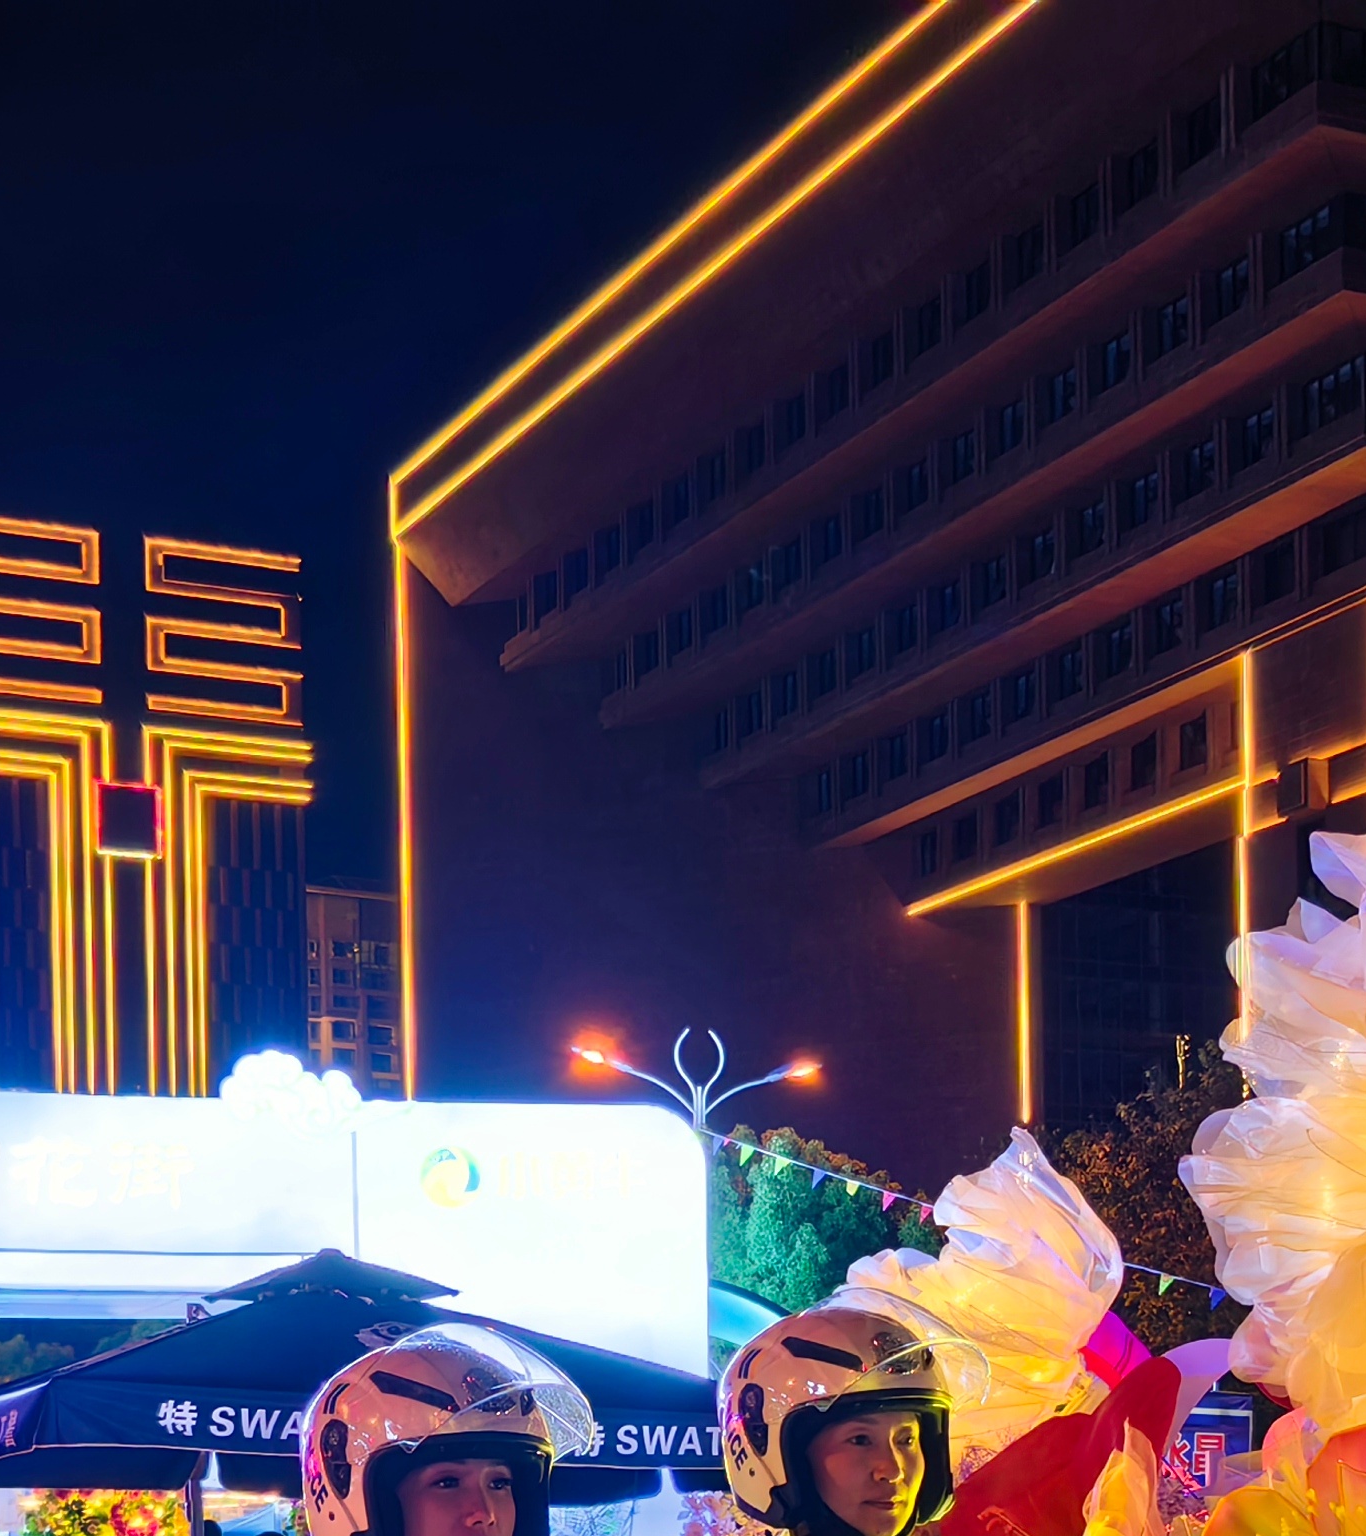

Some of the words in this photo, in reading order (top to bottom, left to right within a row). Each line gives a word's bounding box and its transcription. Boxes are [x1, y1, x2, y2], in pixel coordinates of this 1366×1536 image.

[159, 1400, 198, 1436] 特
[208, 1405, 303, 1440] SWA
[616, 1425, 721, 1457] SWAT
